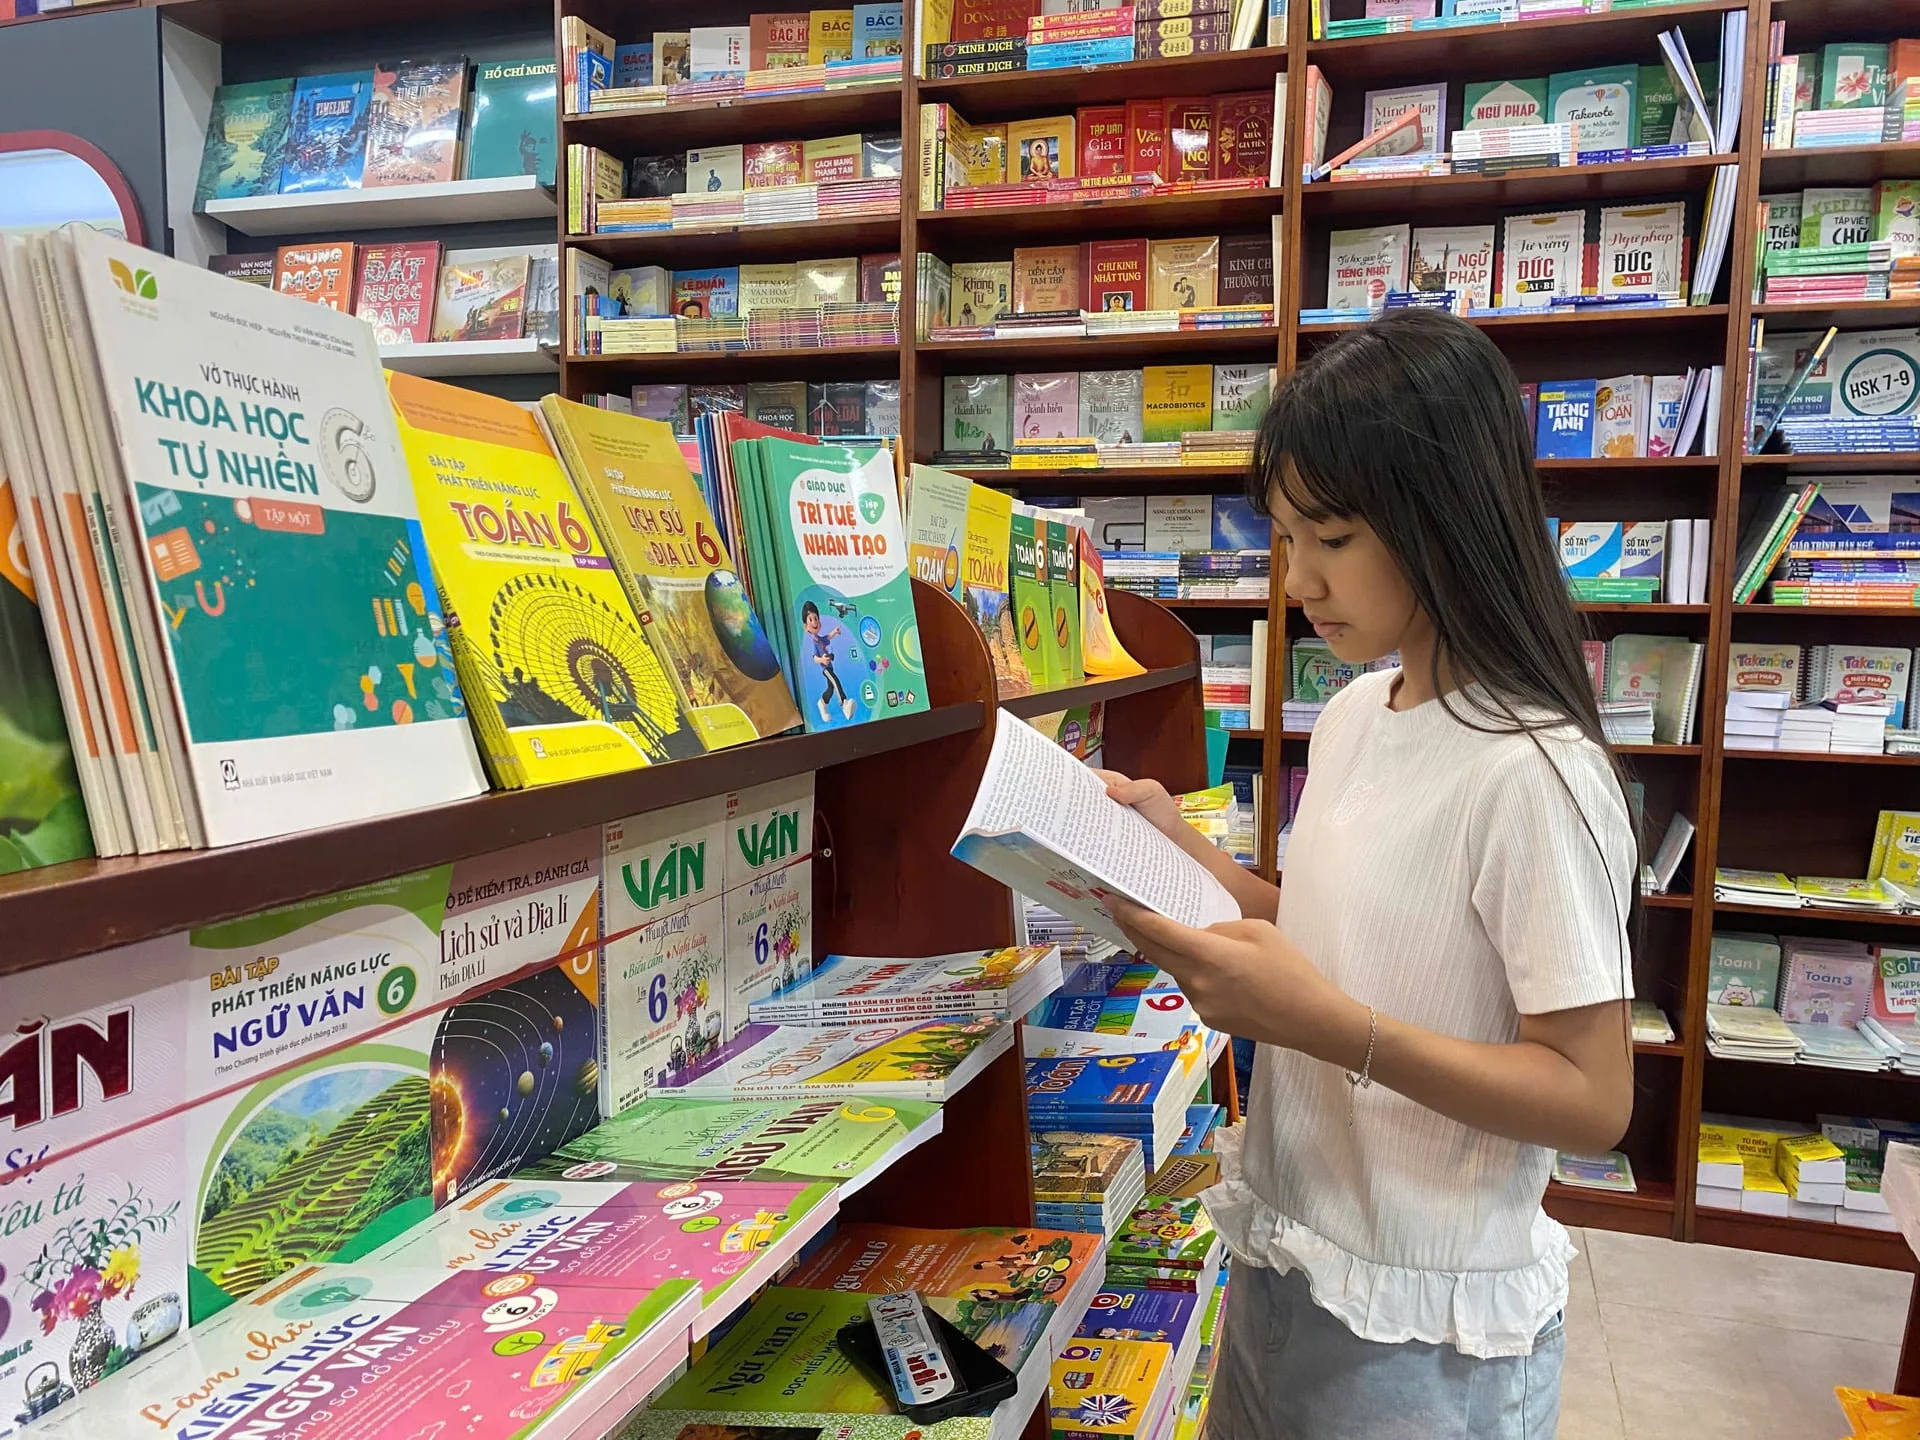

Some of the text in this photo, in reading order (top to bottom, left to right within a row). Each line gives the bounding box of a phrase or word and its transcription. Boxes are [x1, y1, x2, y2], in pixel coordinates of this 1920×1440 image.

[822, 21, 850, 32] BÁC
[866, 15, 895, 27] BÁC
[957, 41, 1013, 55] KINH DỊCH
[484, 66, 501, 80] HỒ
[503, 65, 525, 78] CHÍ
[957, 61, 1013, 73] KINH DỊCH
[315, 100, 351, 116] TIMELINE
[1504, 103, 1535, 118] PHÁP
[1568, 106, 1614, 121] Takenote
[1088, 139, 1105, 151] Gia
[773, 175, 798, 186] Nam
[1834, 214, 1869, 225] TẬP VIẾT
[1832, 226, 1869, 245] CHỮ
[1458, 249, 1489, 268] NGỮ
[1615, 249, 1652, 273] ĐỨC
[1093, 270, 1142, 284] NHẬT TỤNG
[1337, 268, 1363, 278] TIẾNG
[1449, 268, 1487, 284] PHÁP
[1518, 256, 1554, 280] ĐỨC
[281, 265, 341, 293] MỘT
[681, 276, 725, 291] LÊ DUẨN
[200, 362, 301, 402] VỞ THỰC HÀNH
[1220, 369, 1248, 381] ANH
[1850, 377, 1880, 399] HSK
[1882, 369, 1910, 391] 7-9
[1220, 383, 1243, 398] LẠC
[134, 376, 311, 449] KHOA HỌC
[954, 402, 975, 415] thánh
[1024, 401, 1045, 414] thánh
[1146, 401, 1206, 411] MACROBIOTICS
[1547, 401, 1589, 417] TIẾNG
[758, 413, 795, 423] KHOA HỌC
[1552, 417, 1584, 432] ANH
[157, 436, 320, 497] TỰ NHIÊN
[428, 454, 466, 472] BÀI TẬP
[437, 471, 541, 500] PHÁT TRIỂN NĂNG LỰC
[806, 480, 847, 495] GIÁO DỤC
[262, 507, 312, 528] TẬP MỘT
[621, 502, 685, 539] LỊCH SỬ
[797, 500, 857, 530] TRÍ TUỆ
[450, 498, 592, 554] TOÁN 6
[651, 520, 721, 573] ĐỊA LÍ 6
[803, 532, 887, 558] NHÂN TẠO
[1565, 534, 1589, 547] SỔ TAY
[1626, 534, 1650, 547] SỔ TAY
[575, 557, 598, 566] TẬP HAI
[1014, 540, 1035, 565] TOÁN
[1036, 539, 1044, 569] 6
[1051, 543, 1074, 570] TOÁN 6
[1737, 654, 1794, 670] Takenote
[1842, 655, 1905, 673] Takenote
[1312, 663, 1353, 680] Tiếng
[1316, 675, 1349, 688] Anh
[737, 808, 800, 869] VĂN
[622, 840, 706, 911] VĂN
[439, 893, 569, 966] Lịch sử và Địa lí
[572, 926, 593, 976] 6
[755, 922, 769, 966] 6
[210, 956, 279, 991] BÀI TẬP
[440, 965, 460, 991] Phần
[462, 961, 476, 982] ĐỊA
[211, 952, 391, 1018] PHÁT TRIỂN NĂNG LỰC
[387, 975, 405, 1007] 6
[1145, 994, 1185, 1012] 6
[212, 985, 365, 1059] NGỮ VĂN
[847, 1019, 860, 1027] BÀI
[861, 1018, 877, 1026] VĂN
[1063, 998, 1087, 1031] BÀI TẬP
[1096, 1055, 1137, 1068] 6
[840, 1105, 897, 1123] 6
[692, 1141, 788, 1184] NGỮ
[756, 1101, 846, 1139] VĂN
[682, 1200, 700, 1211] 6
[496, 1215, 578, 1260] THỨC
[547, 1221, 615, 1255] VĂN
[1164, 1224, 1182, 1239] 20
[486, 1301, 529, 1319] lớp 6
[263, 1312, 382, 1376] THỨC
[328, 1324, 422, 1373] VĂN
[330, 1317, 463, 1407] sơ đồ tư duy
[707, 1311, 809, 1397] Ngữ văn 6
